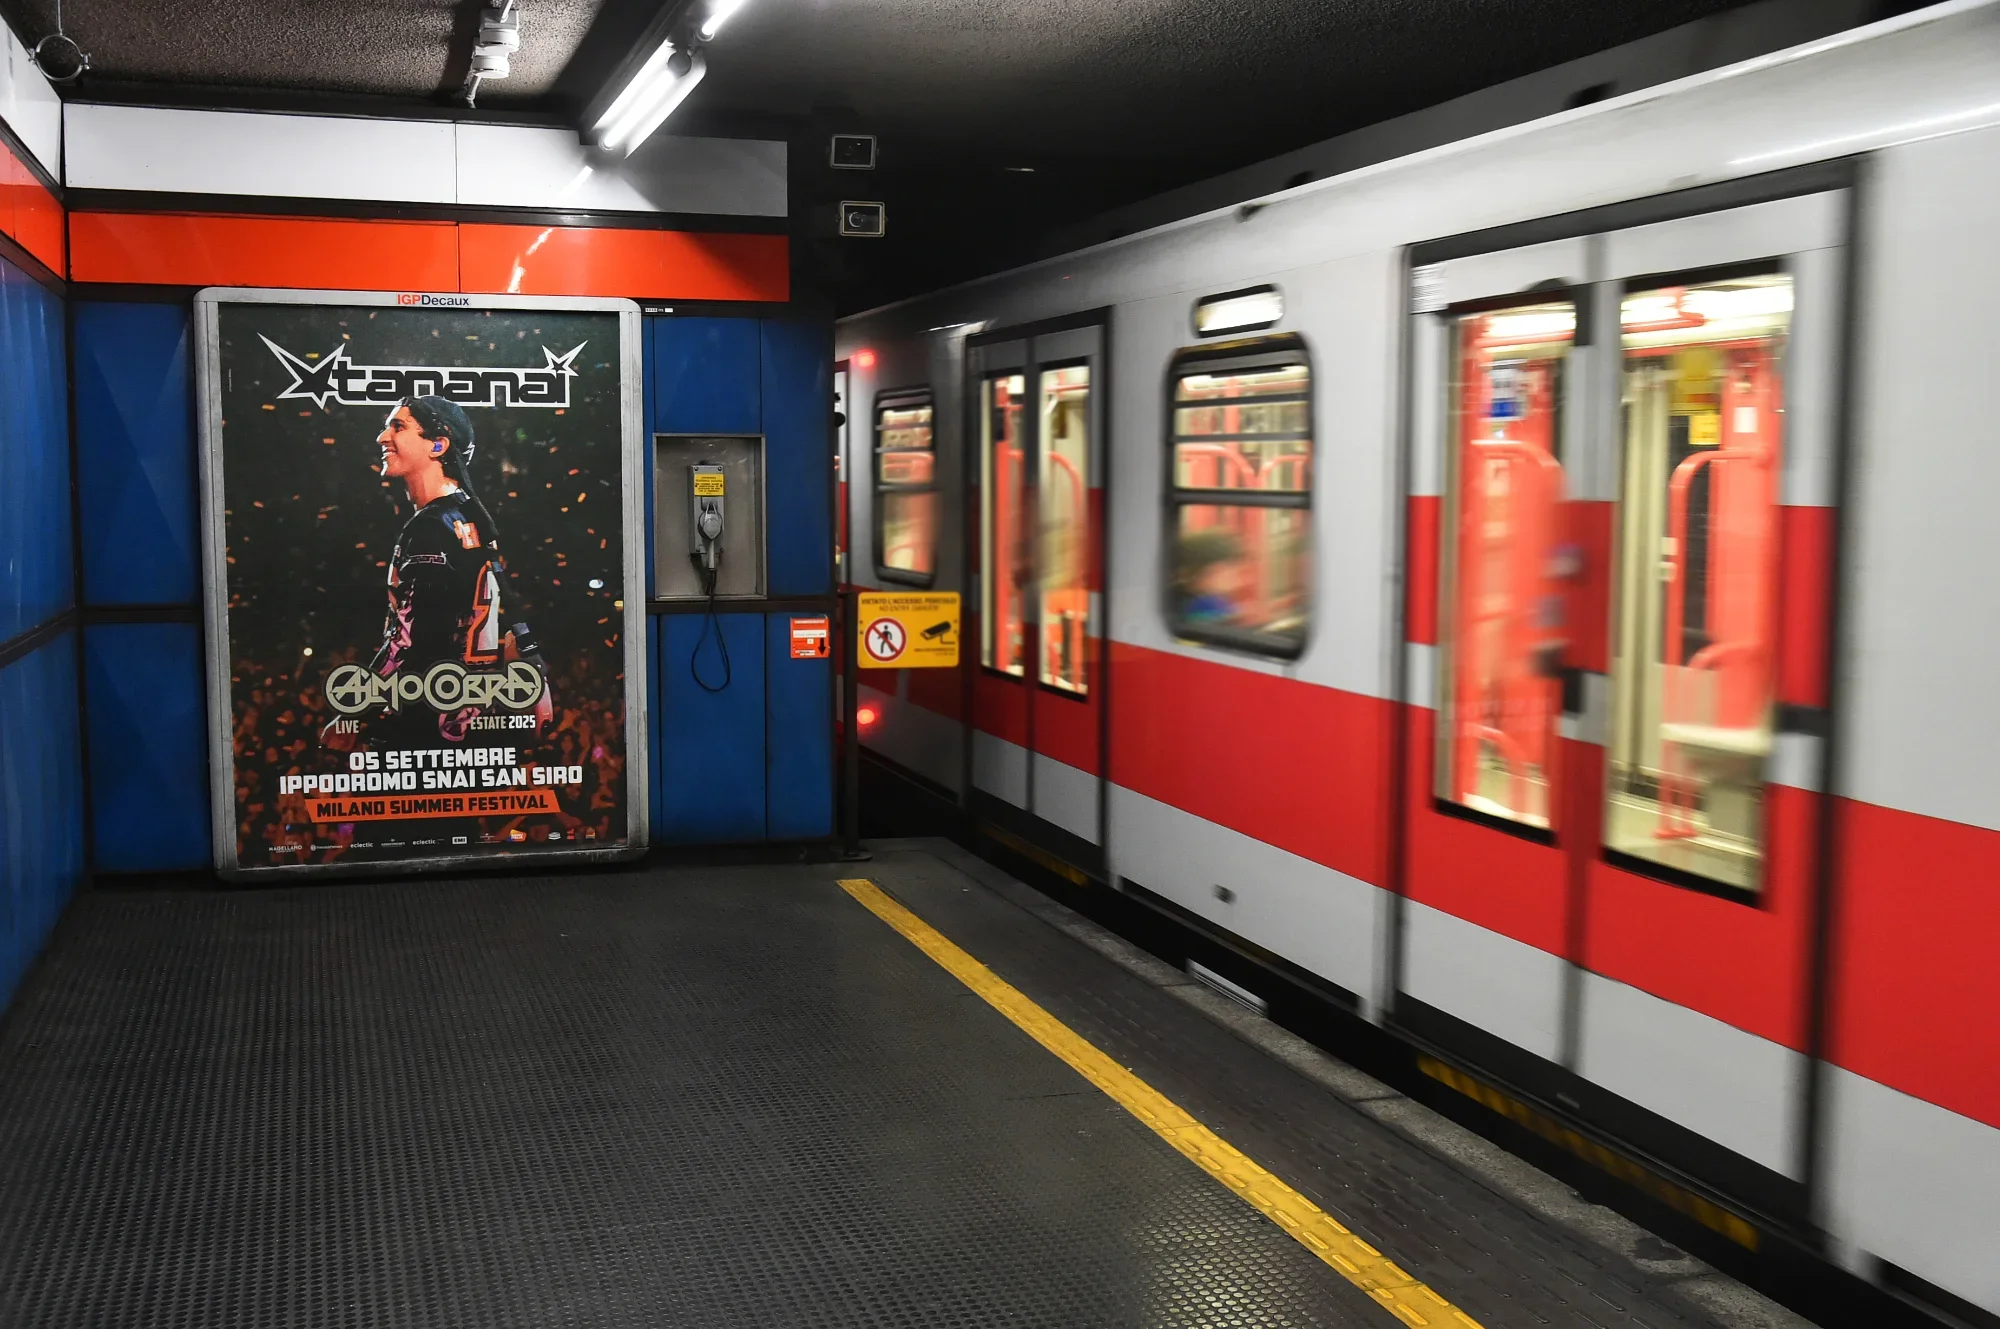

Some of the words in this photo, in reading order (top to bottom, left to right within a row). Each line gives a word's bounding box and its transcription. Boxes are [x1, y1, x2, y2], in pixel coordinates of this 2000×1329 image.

[397, 294, 470, 306] IGPDecaux
[335, 719, 360, 734] LIVE
[470, 716, 507, 730] ESTATE
[508, 715, 536, 729] 2025
[349, 751, 380, 771] 05
[386, 747, 516, 769] SETTEMBRE
[279, 772, 416, 794] IPPODROMO
[423, 769, 476, 789] SNAI
[482, 766, 526, 787] SAN
[532, 765, 583, 785] SIRO
[316, 800, 385, 817] MILANO
[390, 797, 463, 815] SUMMER
[468, 794, 549, 811] FESTIVAL
